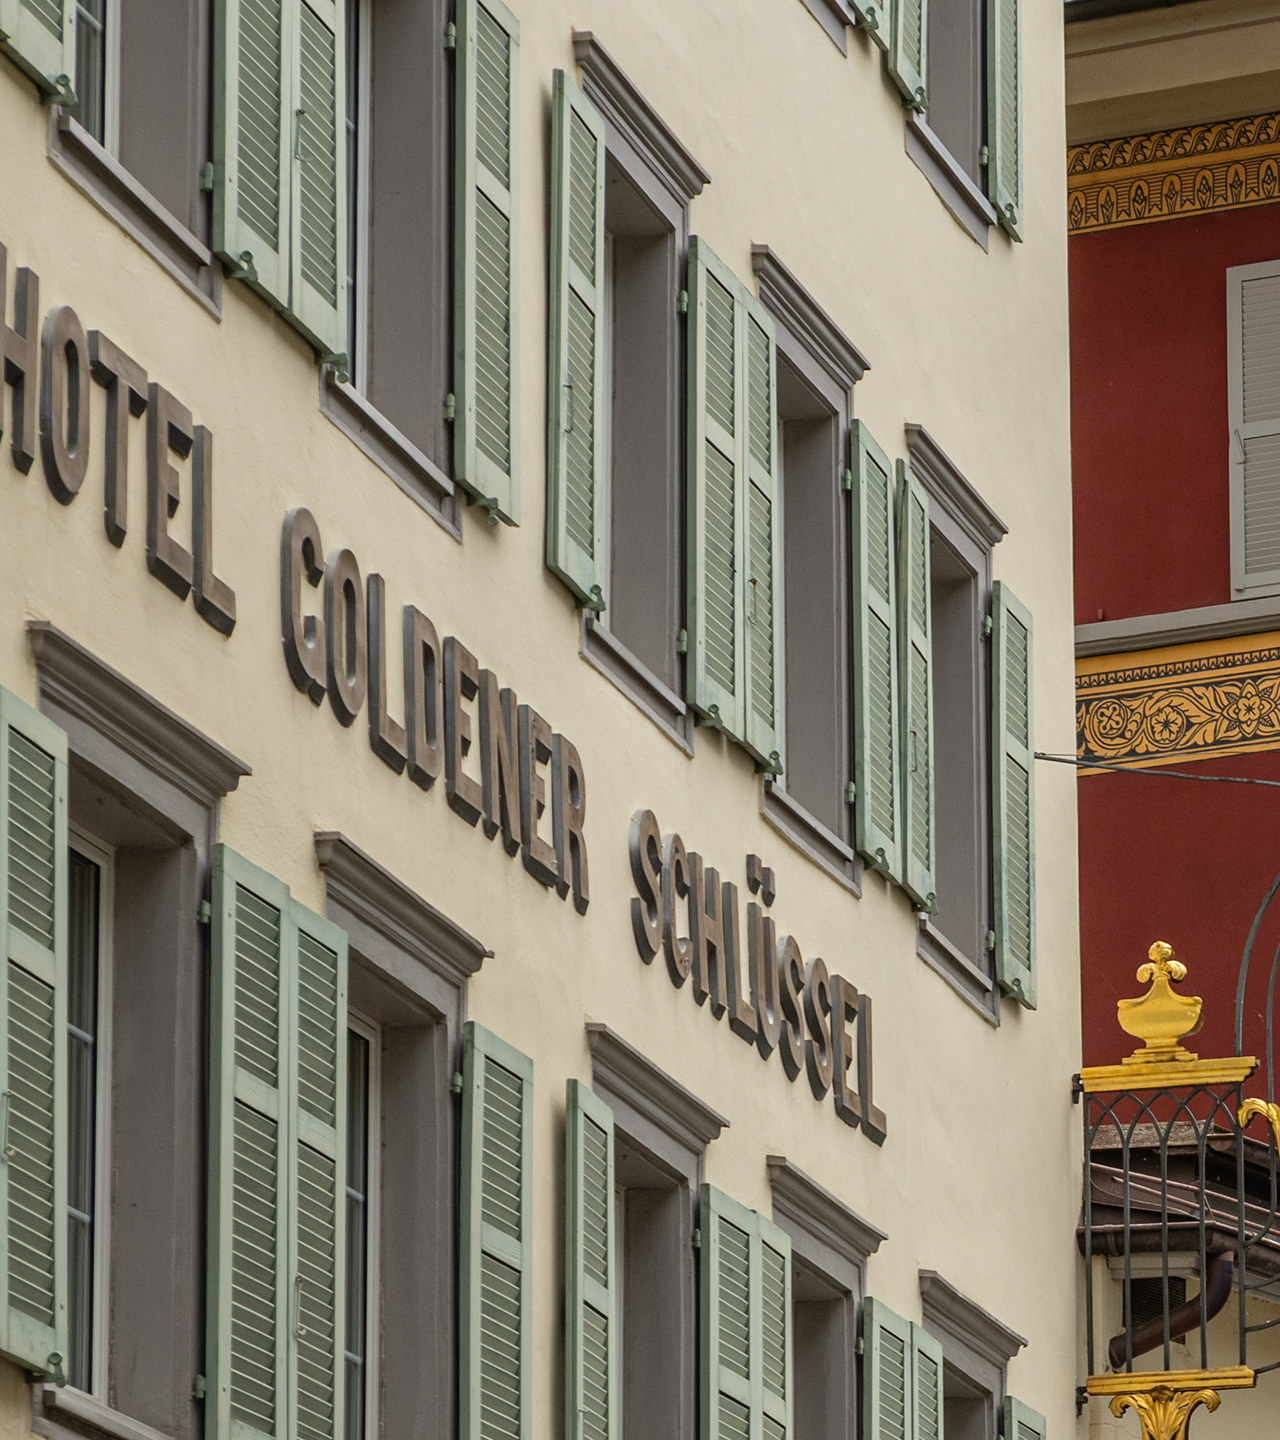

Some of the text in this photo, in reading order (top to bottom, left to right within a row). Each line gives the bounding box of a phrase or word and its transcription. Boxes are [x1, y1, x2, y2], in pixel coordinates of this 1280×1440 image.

[0, 241, 888, 1146] HOTEL GOLDENER SCHLÜSSEL
